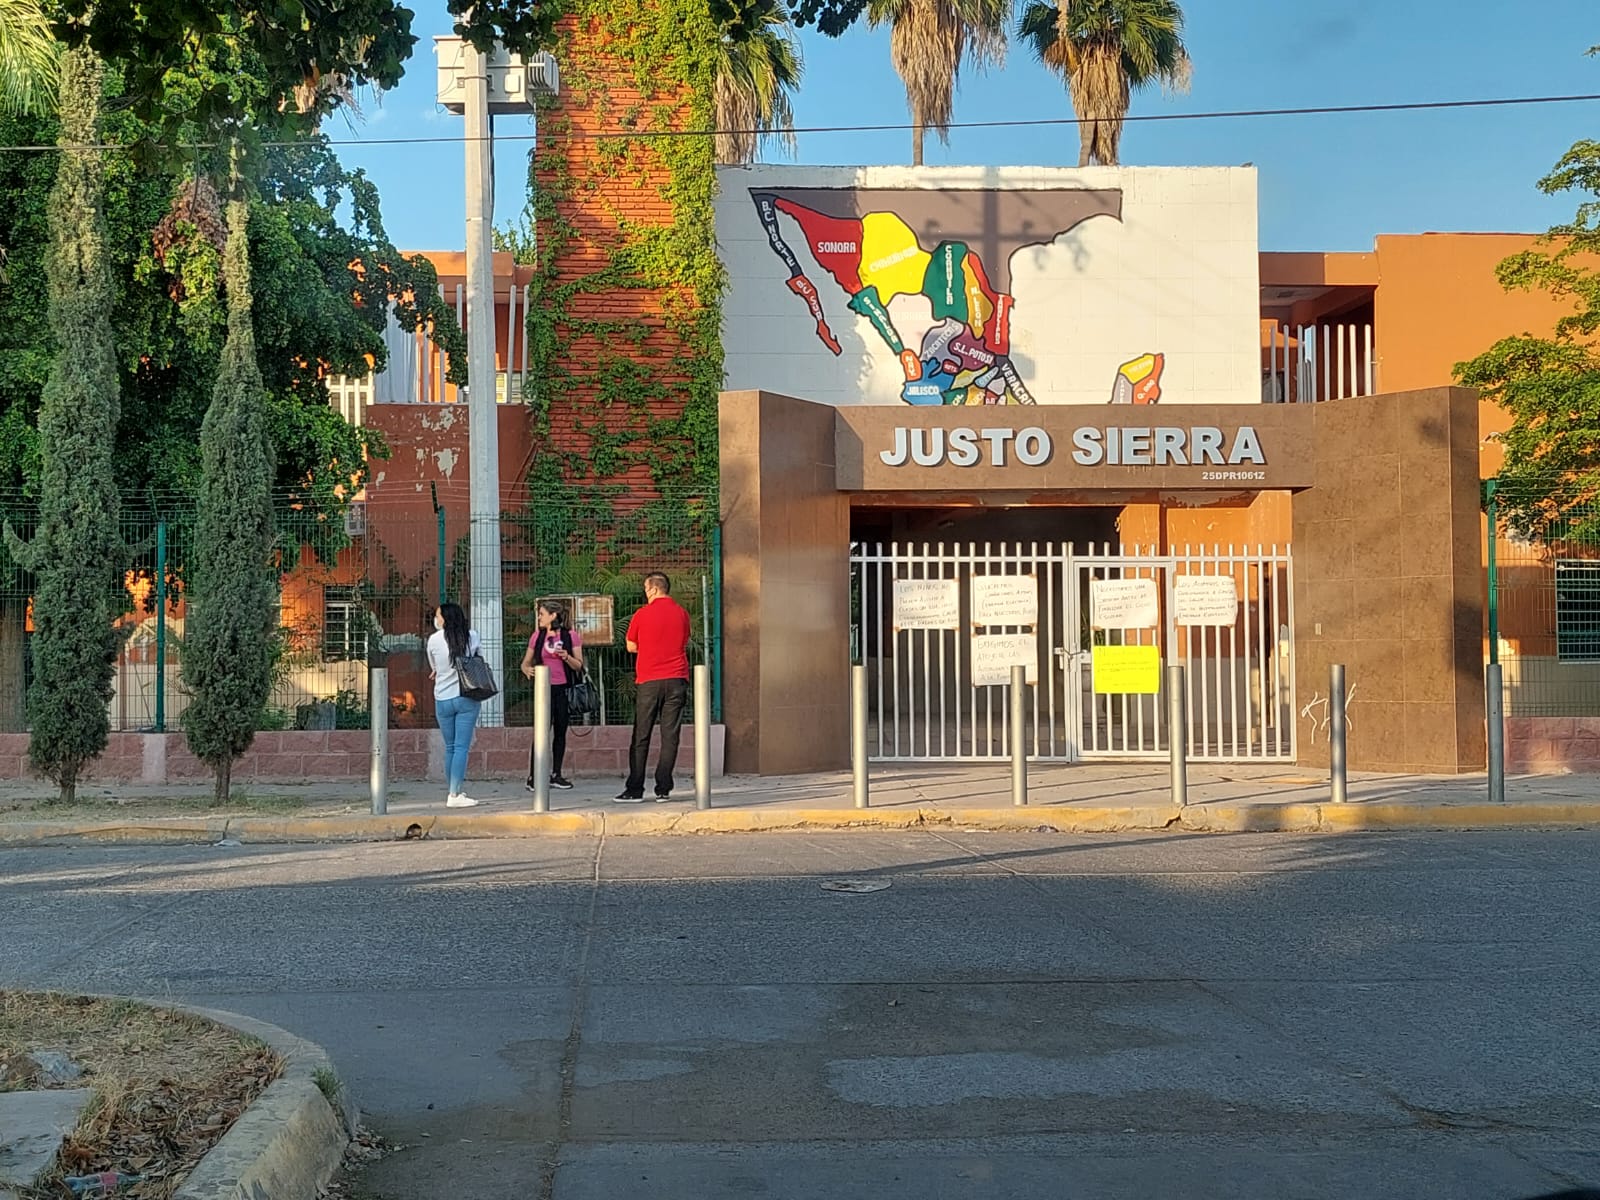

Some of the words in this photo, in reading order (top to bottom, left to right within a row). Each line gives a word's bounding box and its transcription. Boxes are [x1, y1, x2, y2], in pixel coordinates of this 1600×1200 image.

[767, 224, 796, 268] NORTE
[817, 241, 857, 253] SONORA
[862, 296, 899, 345] SINALOA
[968, 347, 994, 365] POTOSI
[906, 385, 940, 397] JALISCO
[879, 427, 1052, 466] JUSTO
[1071, 426, 1266, 466] SIERRA
[1201, 471, 1266, 481] 25DPR1061Z
